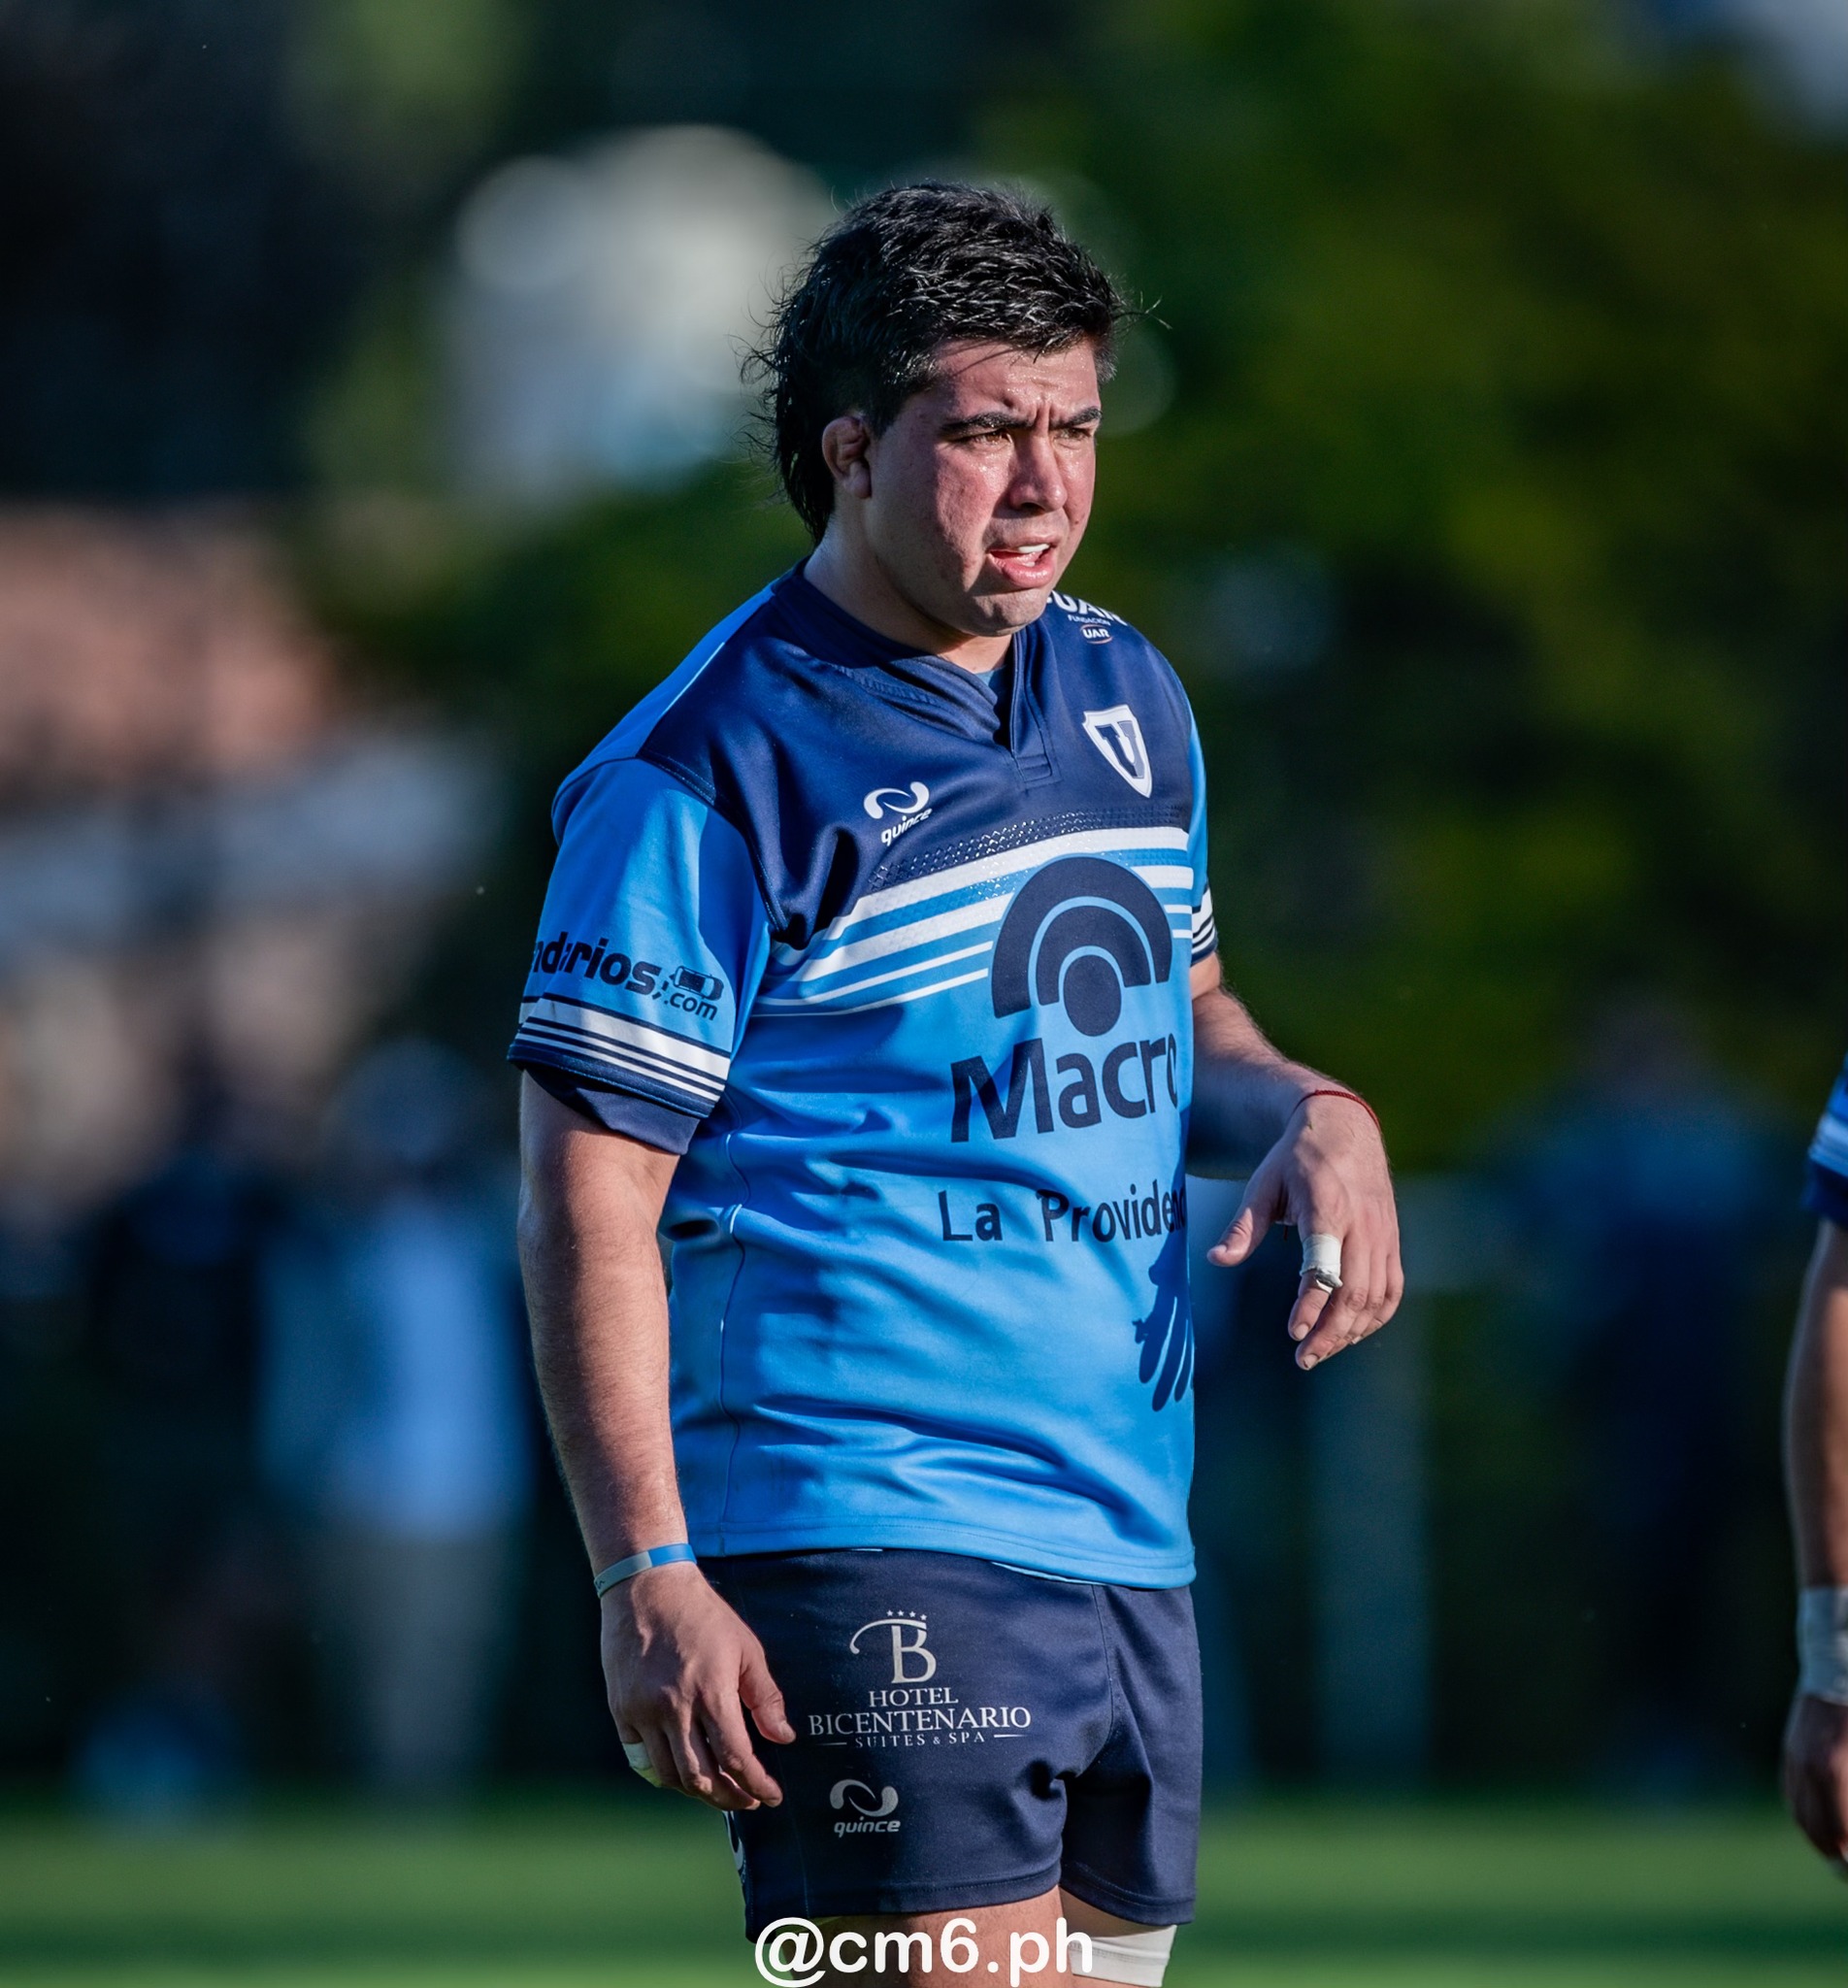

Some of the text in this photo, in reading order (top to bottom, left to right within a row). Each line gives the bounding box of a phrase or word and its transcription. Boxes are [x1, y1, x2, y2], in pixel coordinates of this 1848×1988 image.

[1082, 628, 1110, 639] UAR
[881, 808, 932, 846] quince
[664, 992, 717, 1020] .com
[938, 1190, 1004, 1242] La
[869, 1687, 959, 1707] HOTEL
[808, 1706, 1031, 1736] BICENTENARIO
[855, 1731, 985, 1748] SUITES & SPA
[833, 1816, 901, 1838] quince
